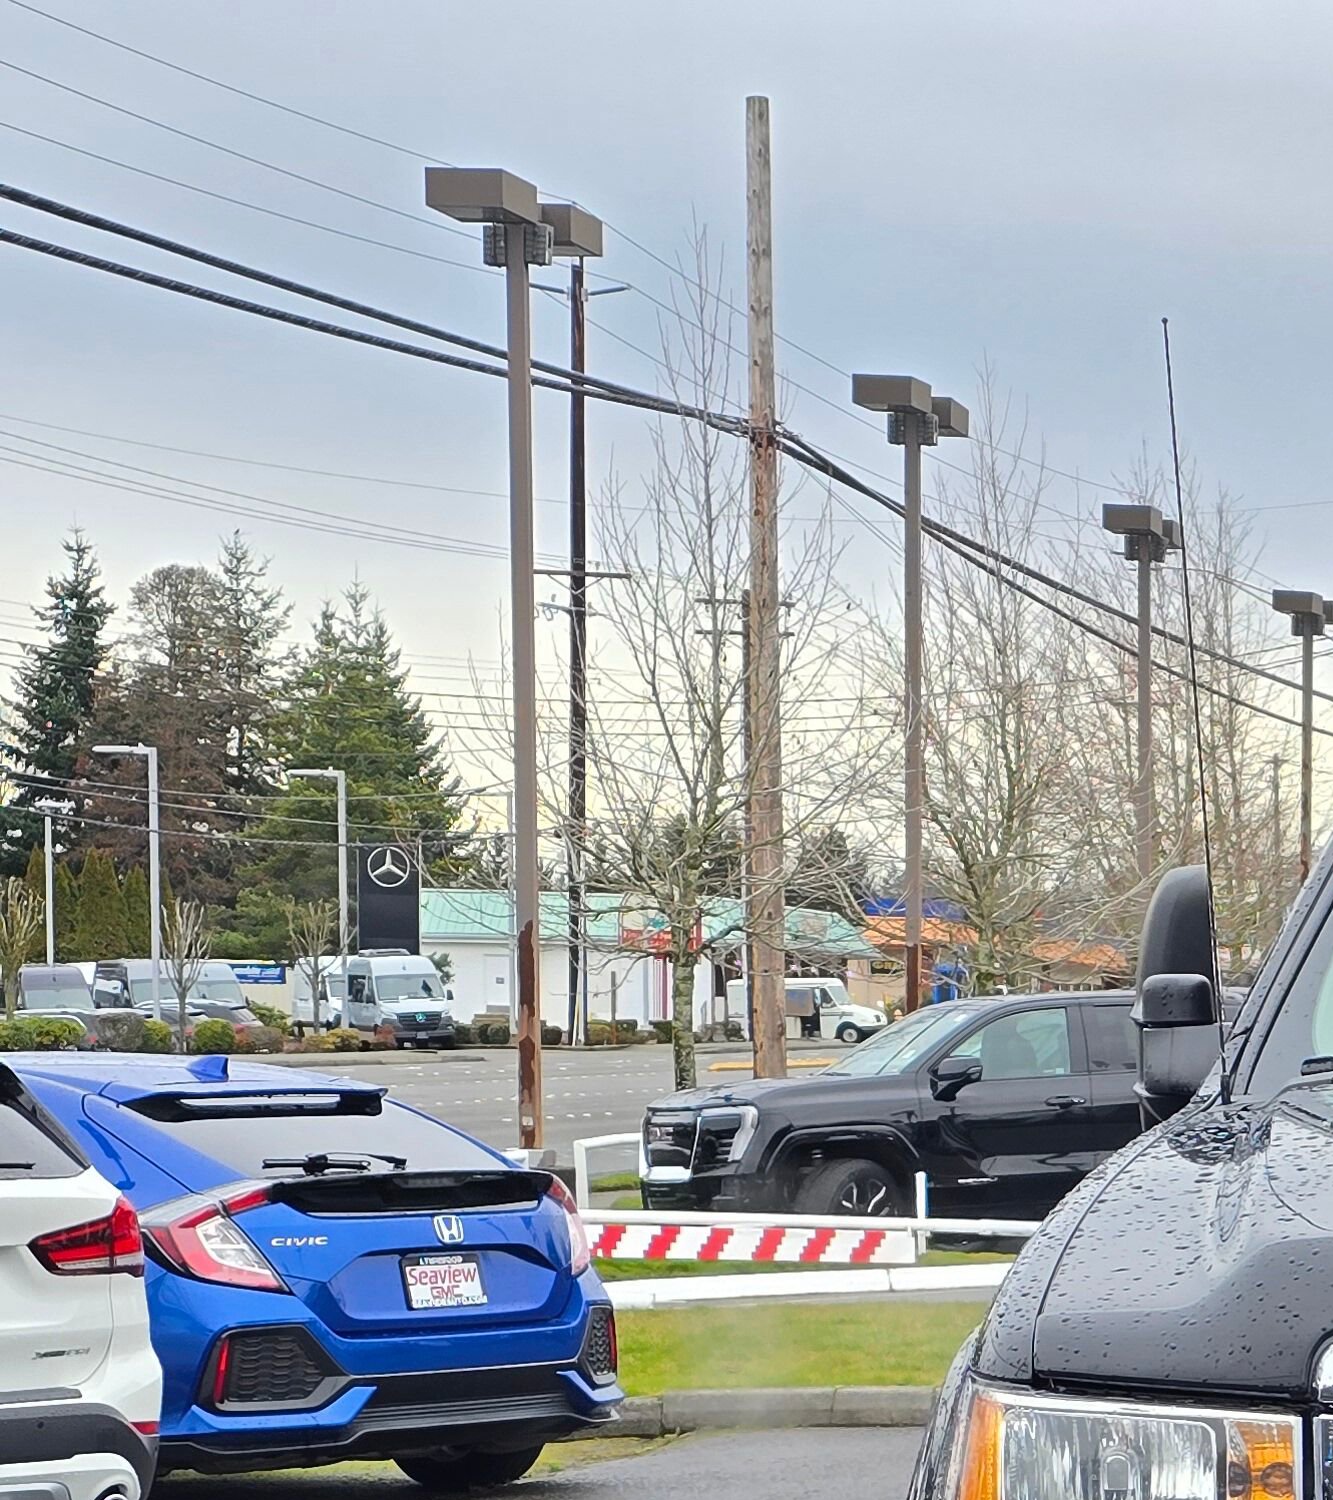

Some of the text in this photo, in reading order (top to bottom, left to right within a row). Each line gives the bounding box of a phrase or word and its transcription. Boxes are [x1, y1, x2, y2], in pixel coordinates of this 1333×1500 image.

[270, 1235, 329, 1248] CIVIC
[408, 1265, 477, 1286] Seaview
[430, 1285, 464, 1299] GMC
